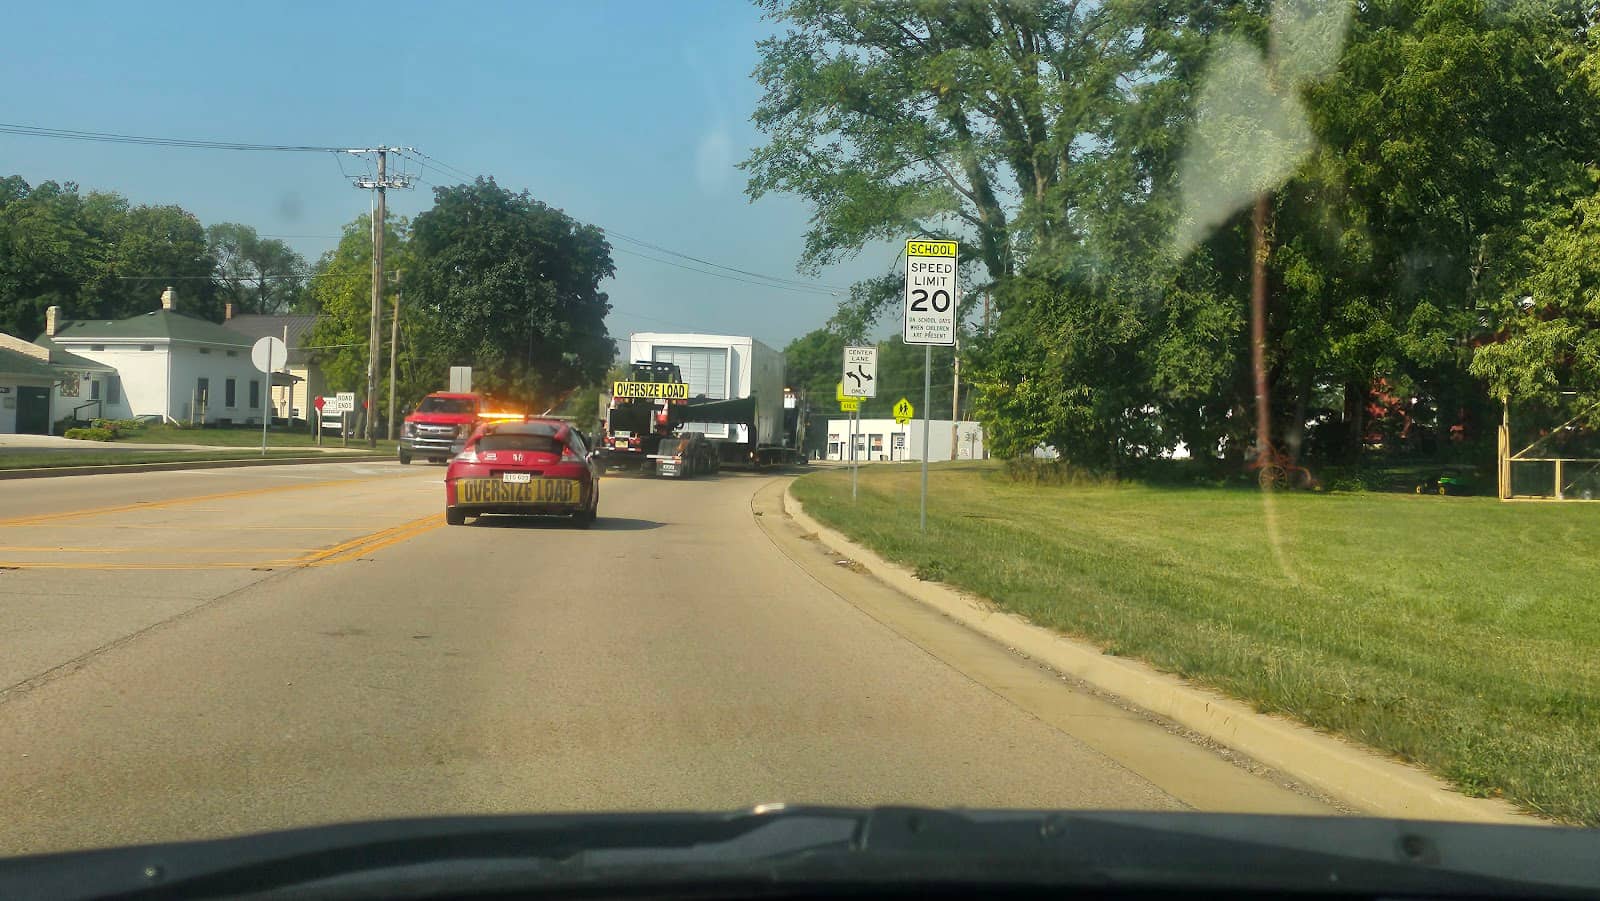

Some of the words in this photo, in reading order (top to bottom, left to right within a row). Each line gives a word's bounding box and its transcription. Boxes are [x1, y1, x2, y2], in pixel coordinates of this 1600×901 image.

[910, 244, 954, 256] SCHOOL
[911, 262, 952, 274] SPEED
[914, 276, 947, 286] LIMIT
[910, 289, 950, 312] 20
[616, 382, 660, 397] OVERSIZE
[662, 384, 685, 398] LOAD
[464, 480, 532, 502] OVERSIZE
[536, 480, 574, 502] LOAD
